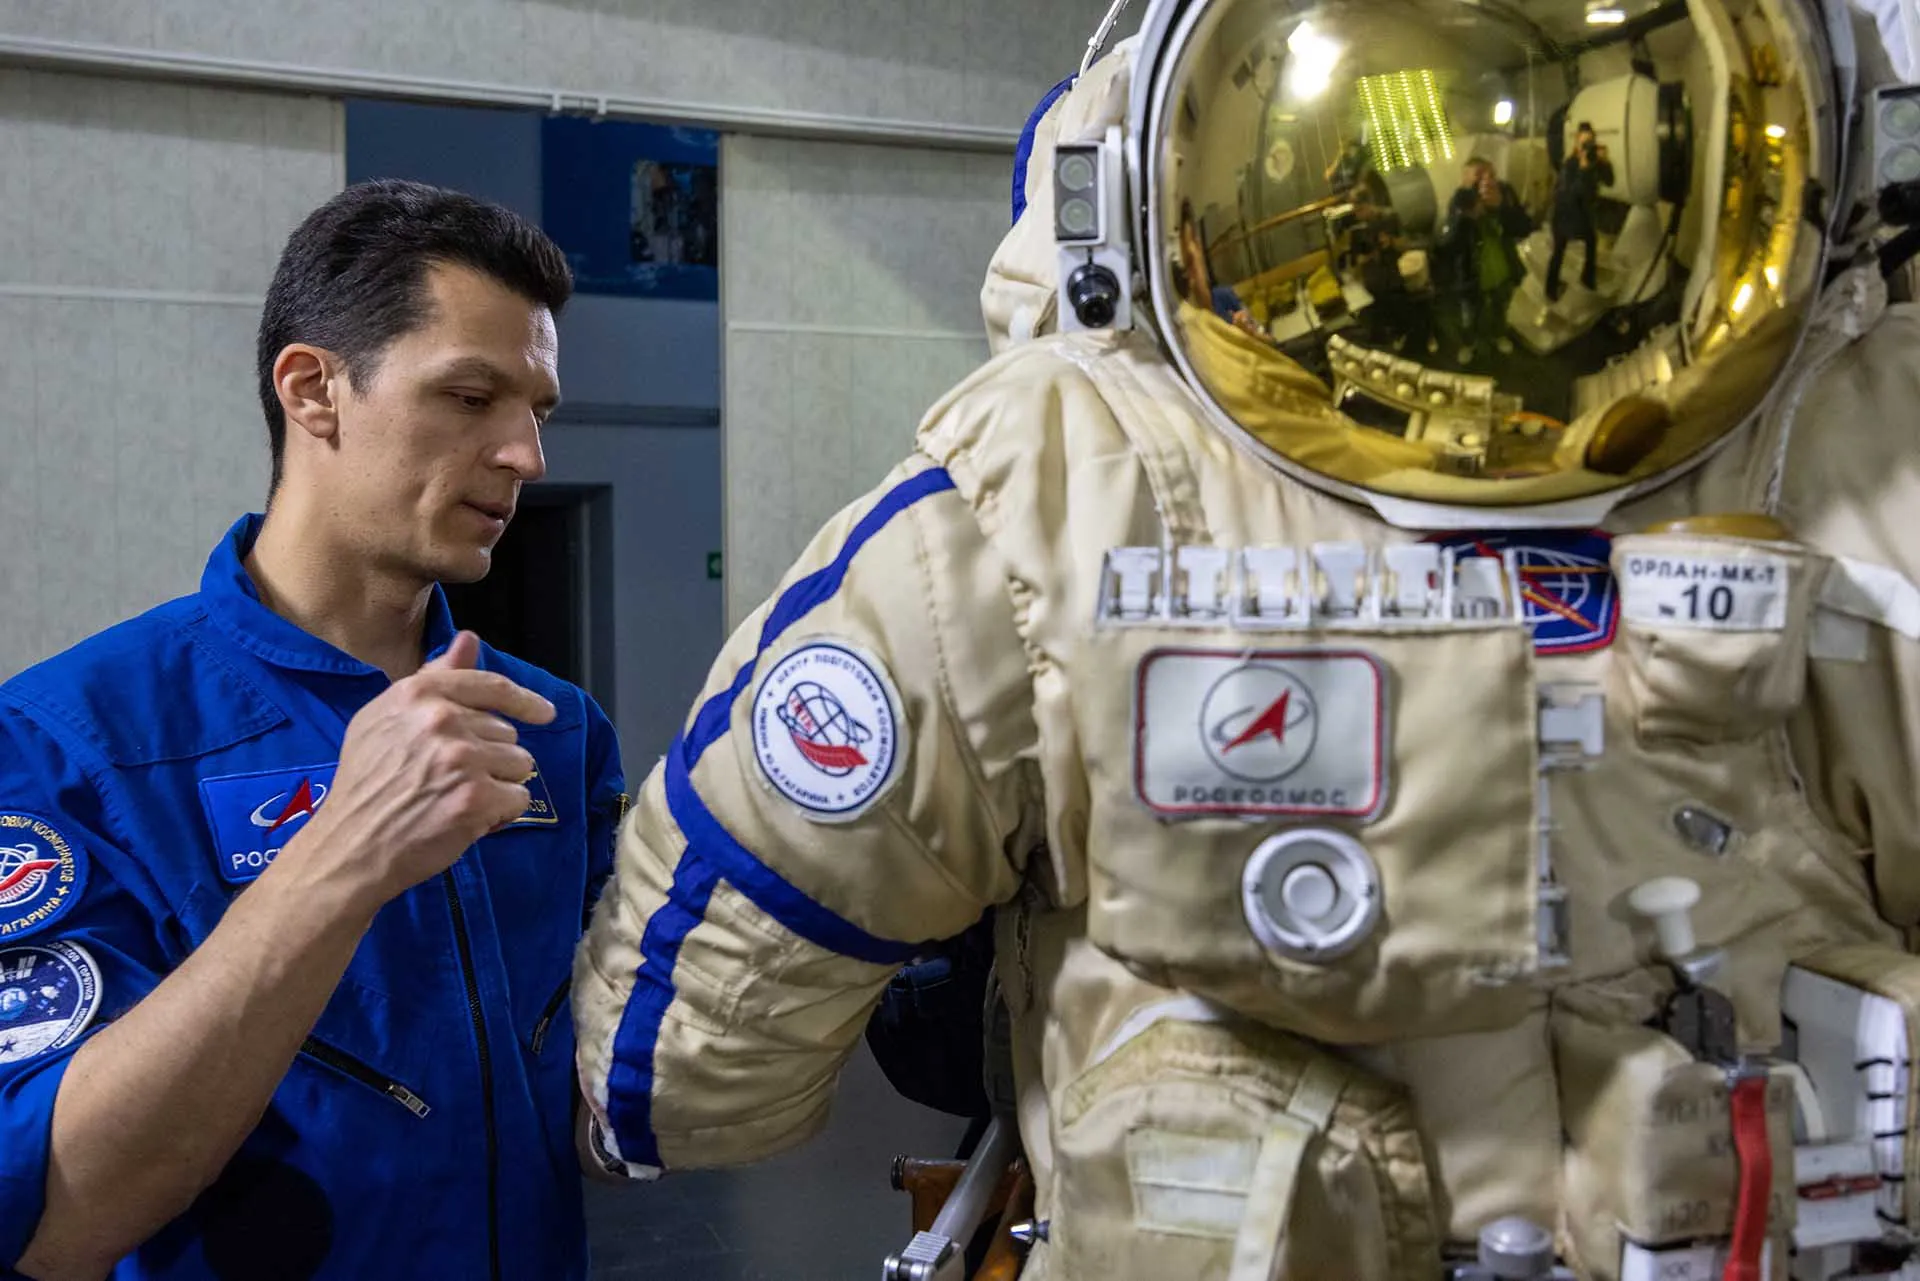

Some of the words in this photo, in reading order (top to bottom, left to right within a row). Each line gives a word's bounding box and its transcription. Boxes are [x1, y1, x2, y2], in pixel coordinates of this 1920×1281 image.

[1173, 785, 1348, 806] РОСКОСМОС
[231, 848, 281, 870] РОС
[0, 896, 62, 935] АГАРИНА
